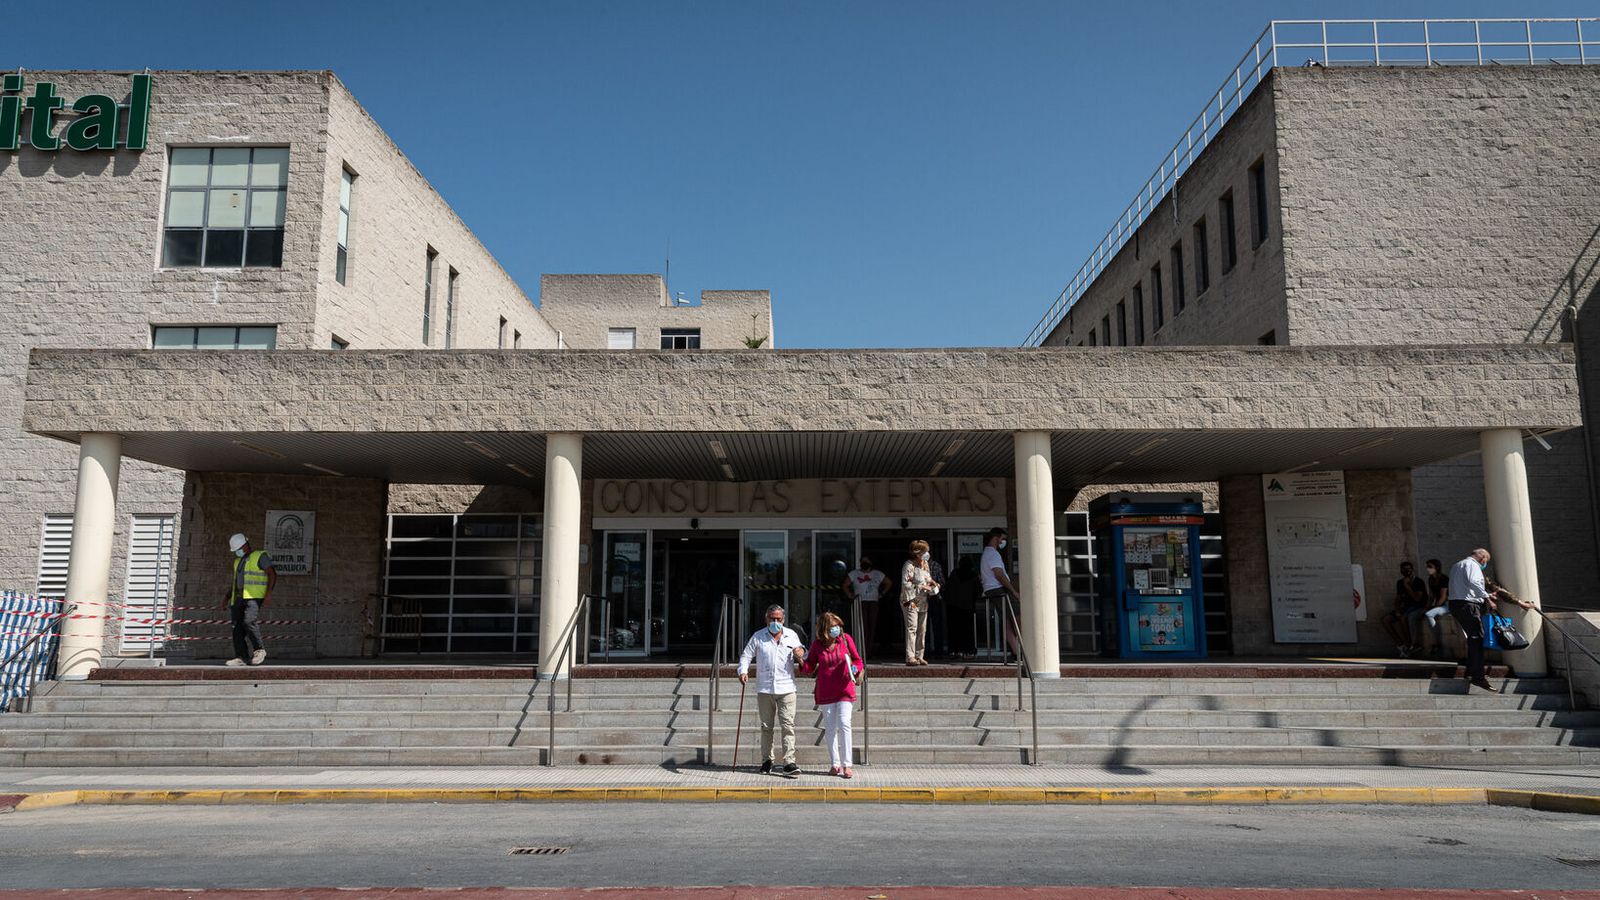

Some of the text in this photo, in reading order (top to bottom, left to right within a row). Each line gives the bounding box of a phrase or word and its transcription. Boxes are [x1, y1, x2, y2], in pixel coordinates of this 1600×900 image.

[601, 478, 998, 513] CONSULTAS EXTERNAS
[271, 555, 305, 563] JUNTA DE
[272, 564, 307, 572] NDALUCIA
